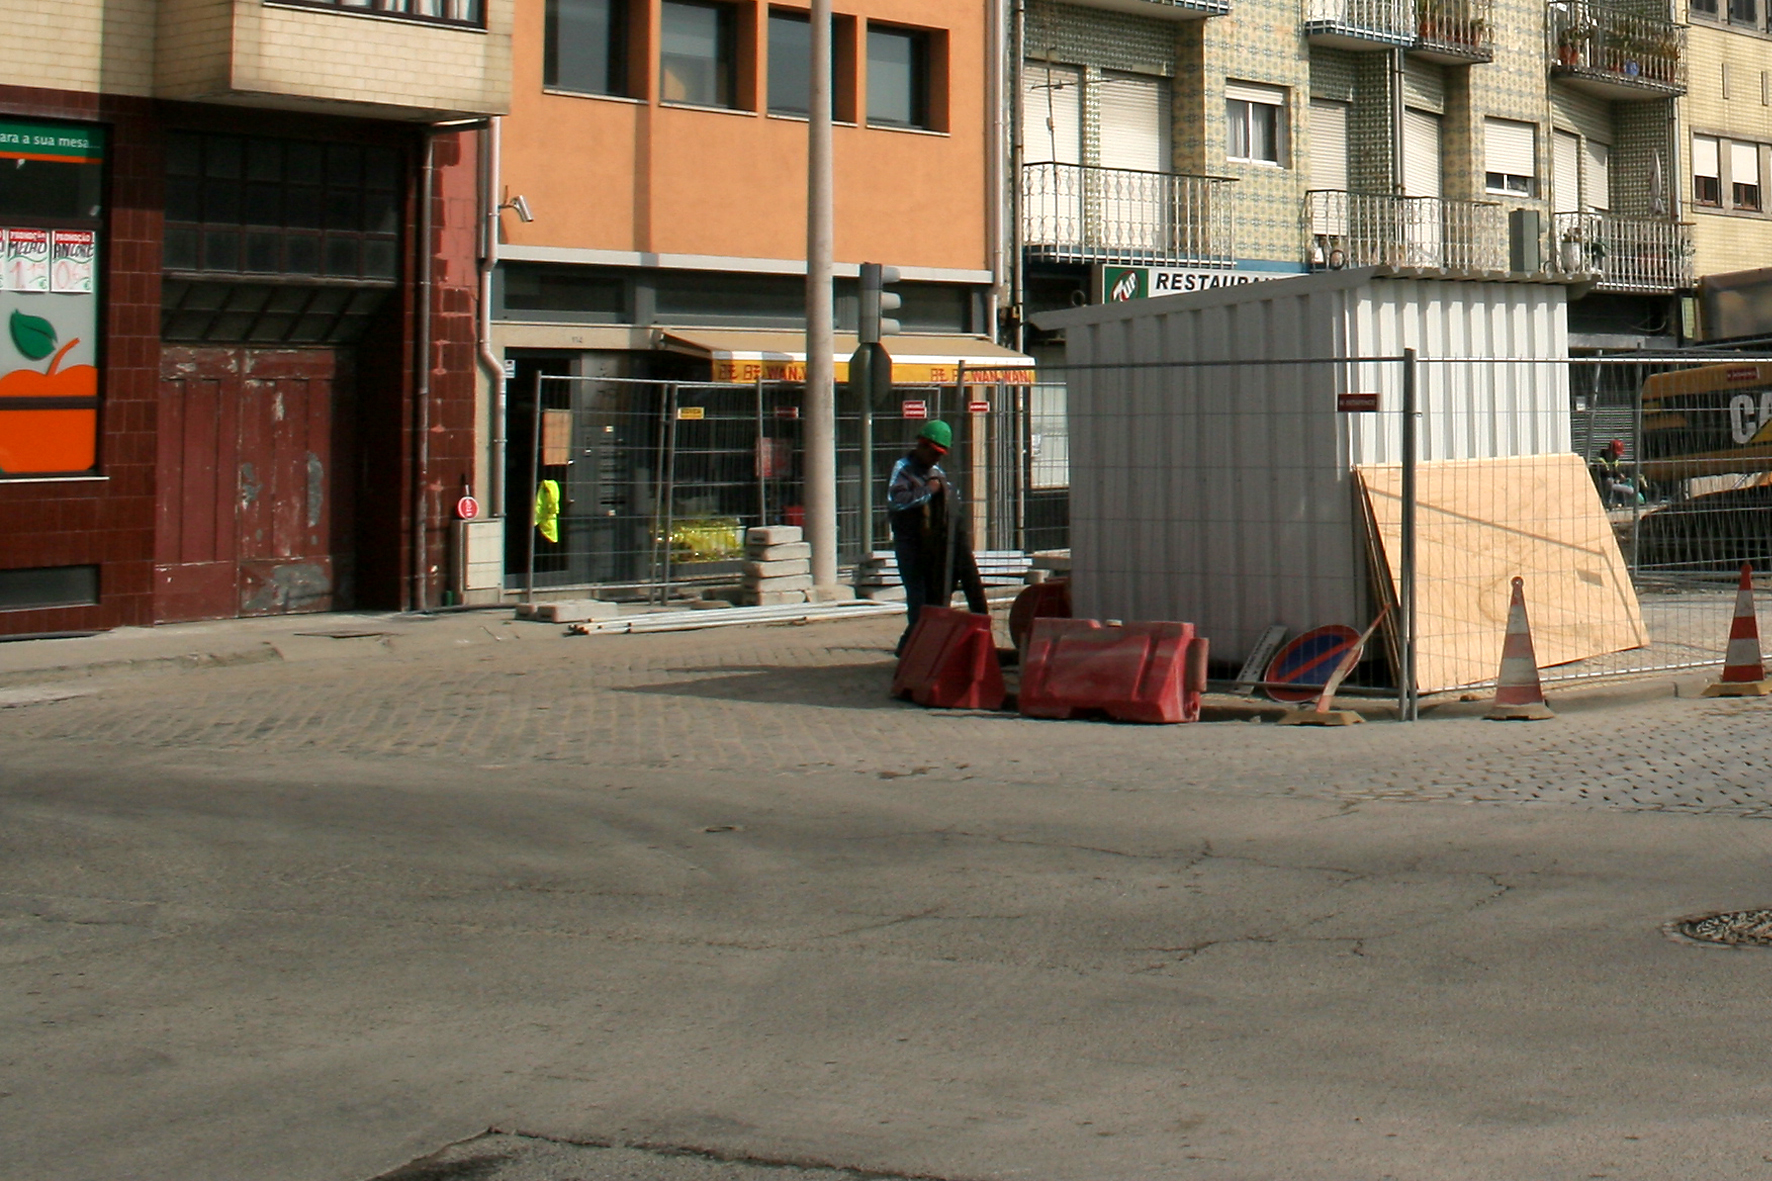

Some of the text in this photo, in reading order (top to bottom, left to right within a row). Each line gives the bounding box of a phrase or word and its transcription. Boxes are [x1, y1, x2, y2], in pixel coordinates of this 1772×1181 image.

[0, 133, 19, 143] ara
[23, 134, 30, 145] a
[33, 135, 55, 146] sua
